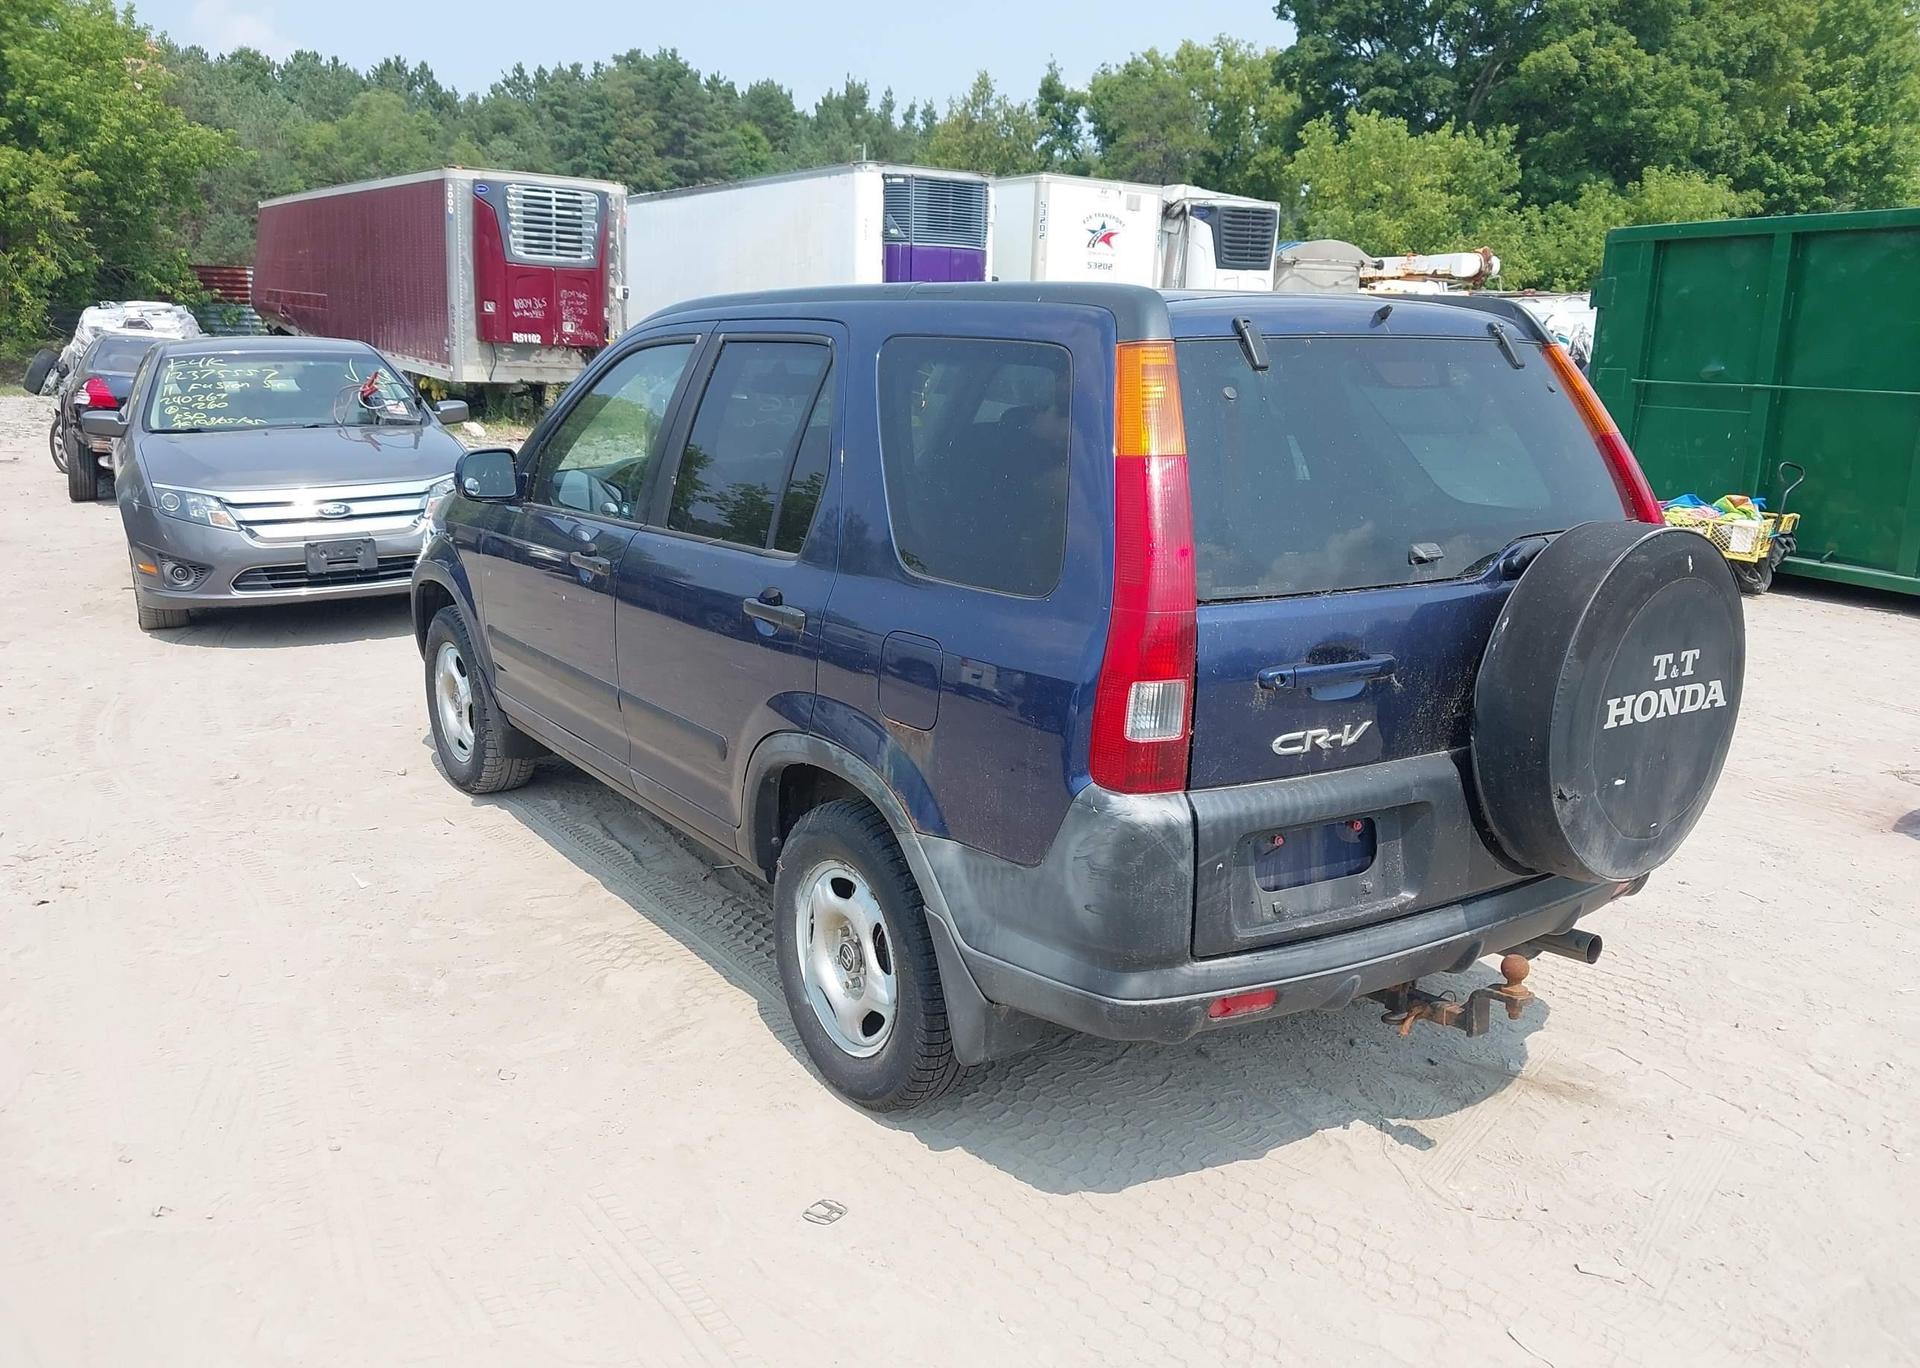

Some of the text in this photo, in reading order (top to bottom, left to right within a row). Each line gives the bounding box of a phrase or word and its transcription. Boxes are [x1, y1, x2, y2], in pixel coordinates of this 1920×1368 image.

[1087, 261, 1113, 270] 53202
[512, 332, 541, 344] R51102
[1603, 679, 1727, 730] HONDA
[1271, 720, 1374, 756] CR-V
